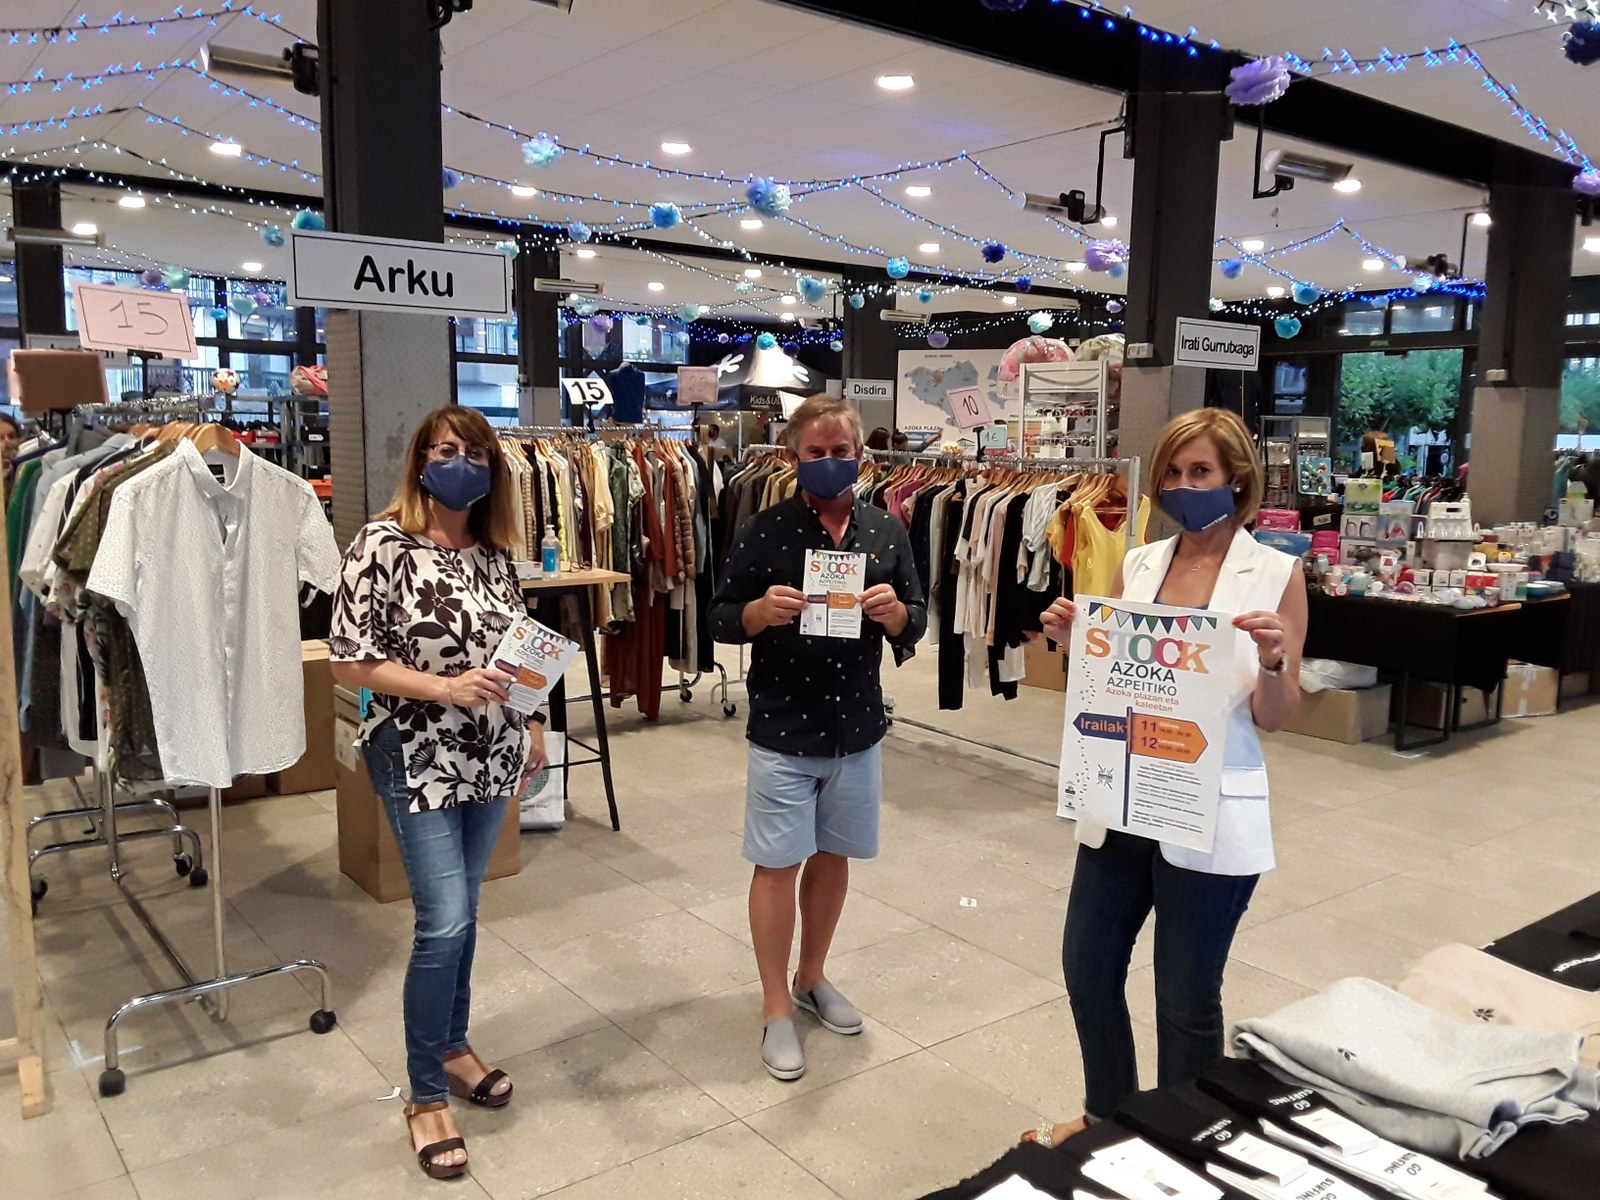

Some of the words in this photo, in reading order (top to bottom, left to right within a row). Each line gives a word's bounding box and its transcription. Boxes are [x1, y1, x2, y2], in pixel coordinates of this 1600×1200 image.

[353, 254, 454, 298] Arku
[110, 299, 169, 335] 15
[1181, 335, 1200, 351] Irati
[1202, 337, 1254, 359] Gurrutxaga
[571, 381, 605, 400] 15
[853, 384, 887, 395] Disdira
[962, 395, 979, 416] 10
[810, 560, 858, 575] STOCK
[519, 643, 546, 660] AZOKA
[1084, 627, 1211, 674] STOCK
[1110, 661, 1176, 683] AZOKA
[1106, 676, 1177, 697] AZPEITIKO
[1105, 686, 1132, 698] Azoka
[1134, 691, 1163, 704] plazan
[1165, 696, 1180, 706] eta
[1135, 700, 1173, 713] kaleetan
[1080, 717, 1124, 734] Irailak
[1141, 719, 1157, 733] 11
[1141, 736, 1158, 750] 12
[1293, 1100, 1311, 1111] GO
[1213, 1130, 1232, 1141] GO
[1406, 1163, 1422, 1176] GO
